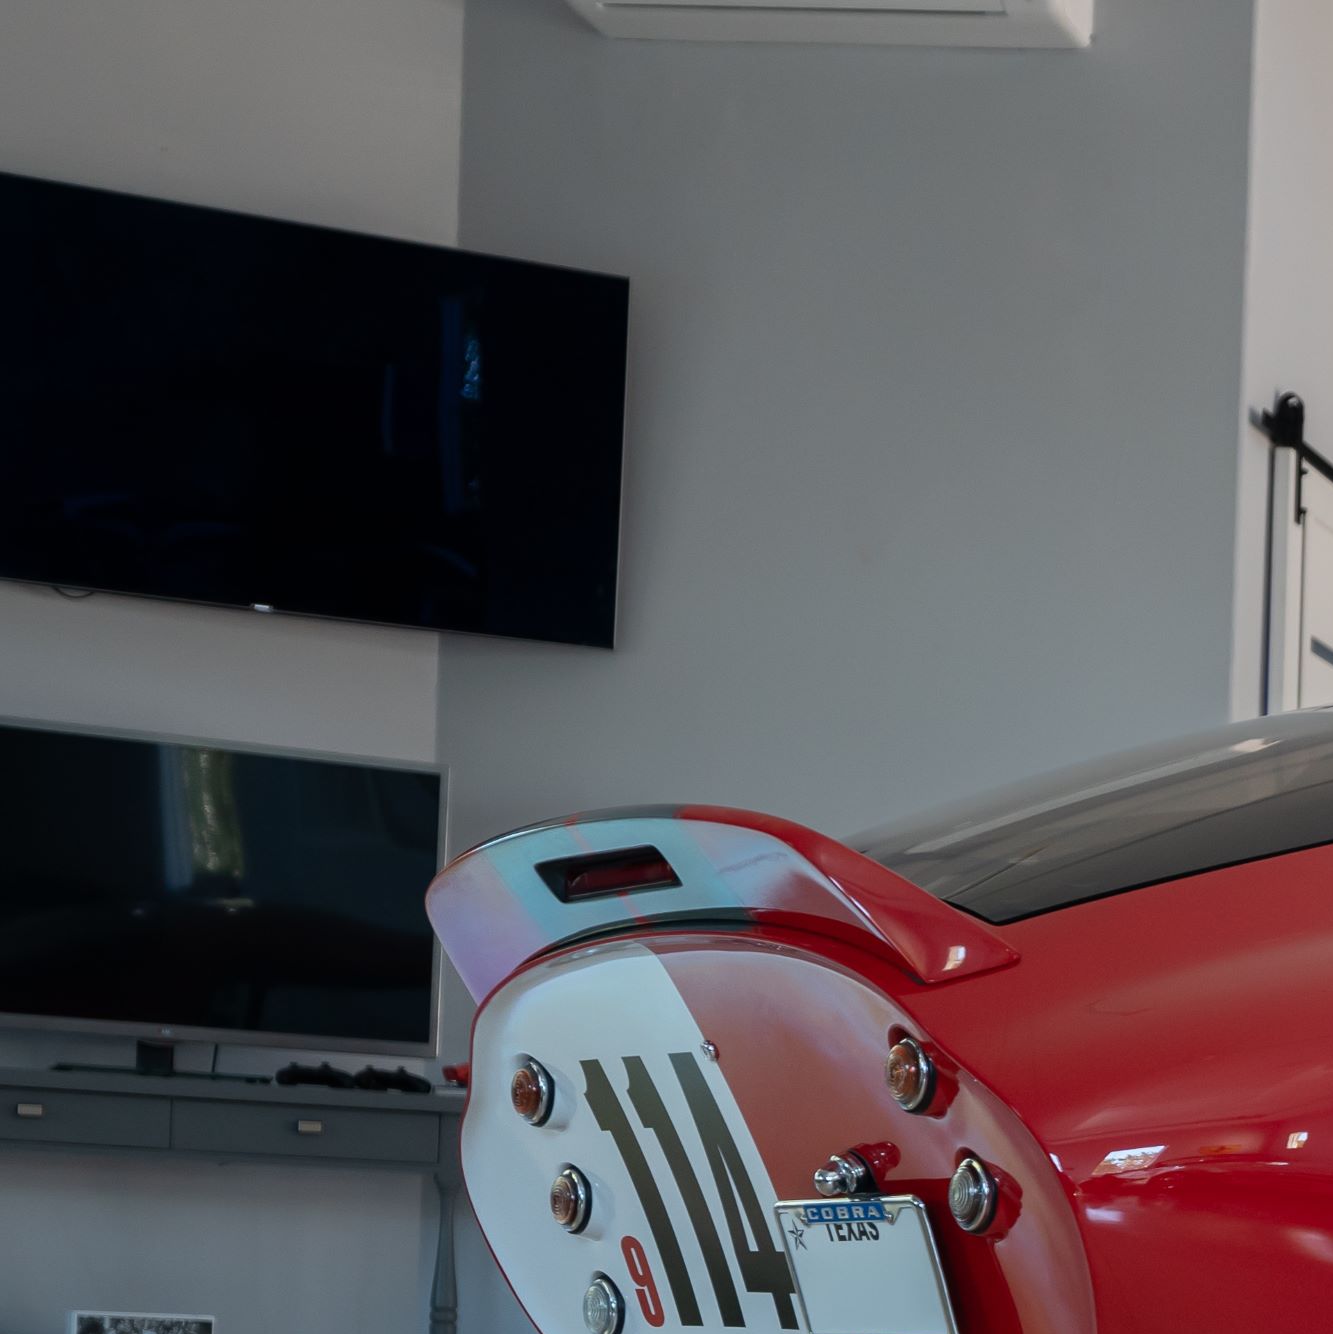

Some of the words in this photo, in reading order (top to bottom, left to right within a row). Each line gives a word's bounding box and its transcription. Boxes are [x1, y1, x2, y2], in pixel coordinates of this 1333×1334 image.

[579, 1051, 799, 1330] 114
[806, 1205, 881, 1220] COBRA
[620, 1235, 665, 1327] 9
